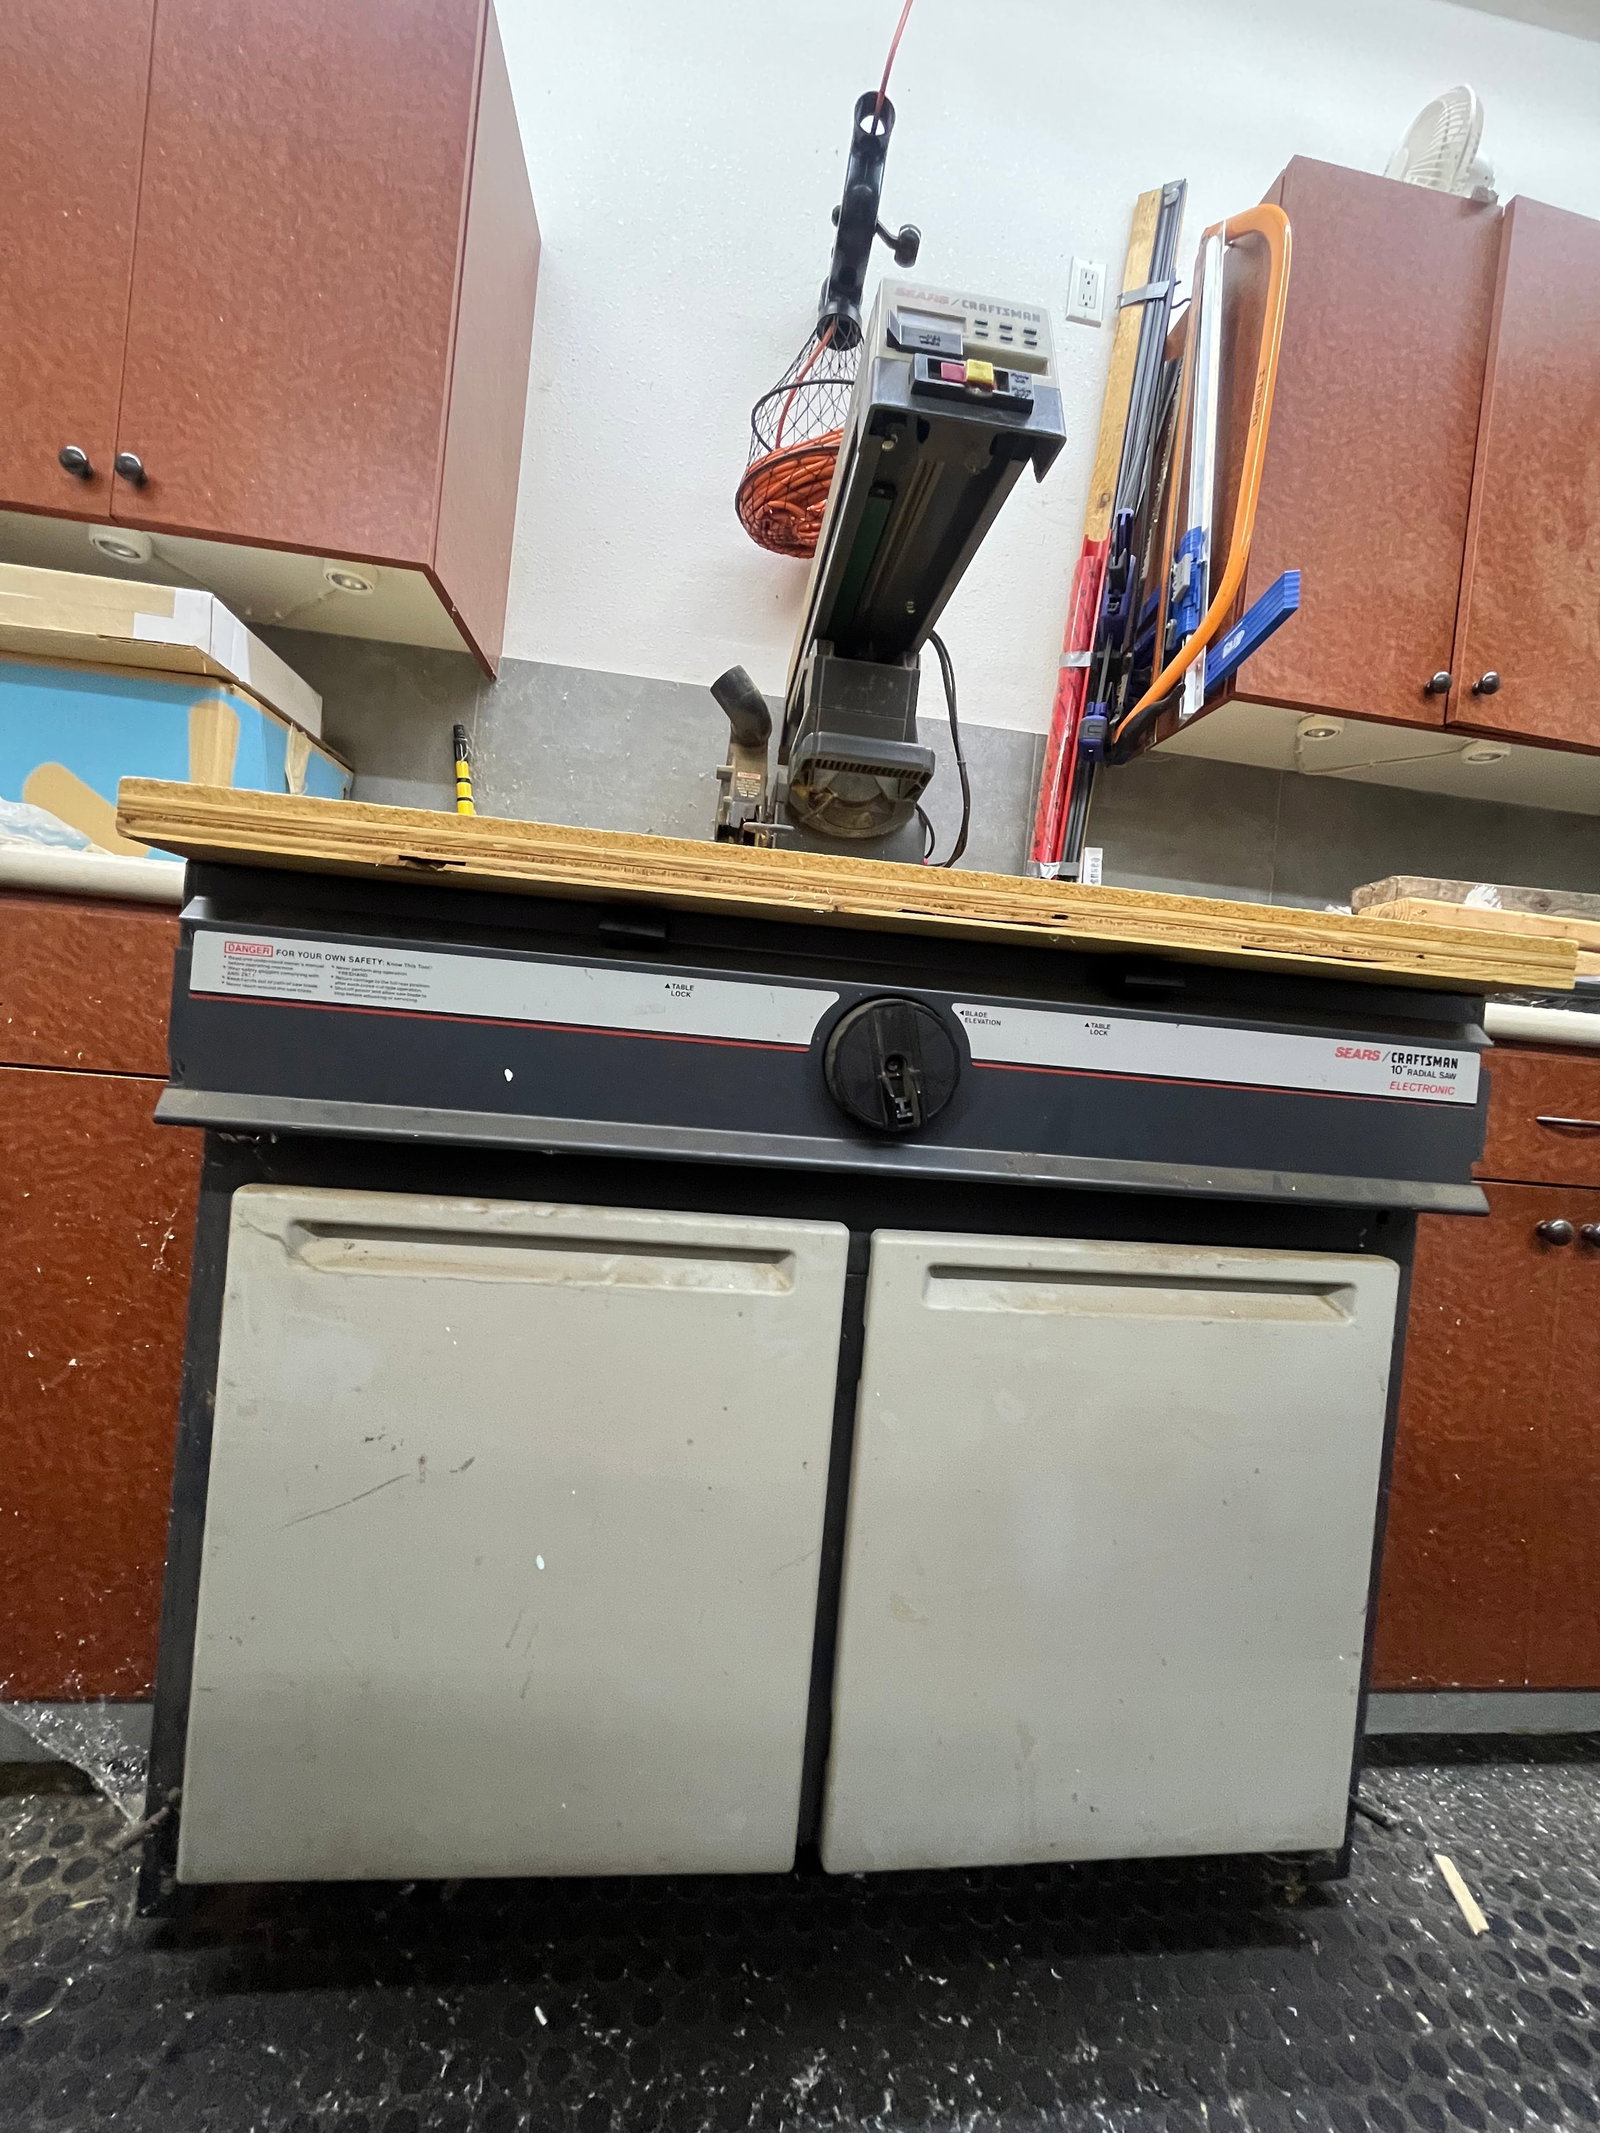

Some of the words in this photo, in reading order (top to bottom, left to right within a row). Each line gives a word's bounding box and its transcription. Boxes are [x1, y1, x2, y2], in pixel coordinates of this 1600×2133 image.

[228, 943, 270, 955] DANGER
[276, 949, 295, 957] FOR
[298, 951, 322, 960] YOUR
[325, 953, 346, 962] OWN
[348, 955, 384, 966] SAFETY:
[672, 983, 694, 991] TABLE
[671, 990, 691, 998] LOCK
[965, 1010, 988, 1018] BLADE
[964, 1017, 1002, 1026] ELEVATION
[1091, 1022, 1111, 1030] TABLE
[1407, 1069, 1437, 1079] RADIAL
[1439, 1071, 1457, 1080] SAW
[1389, 1080, 1455, 1095] ELECTRONIC
